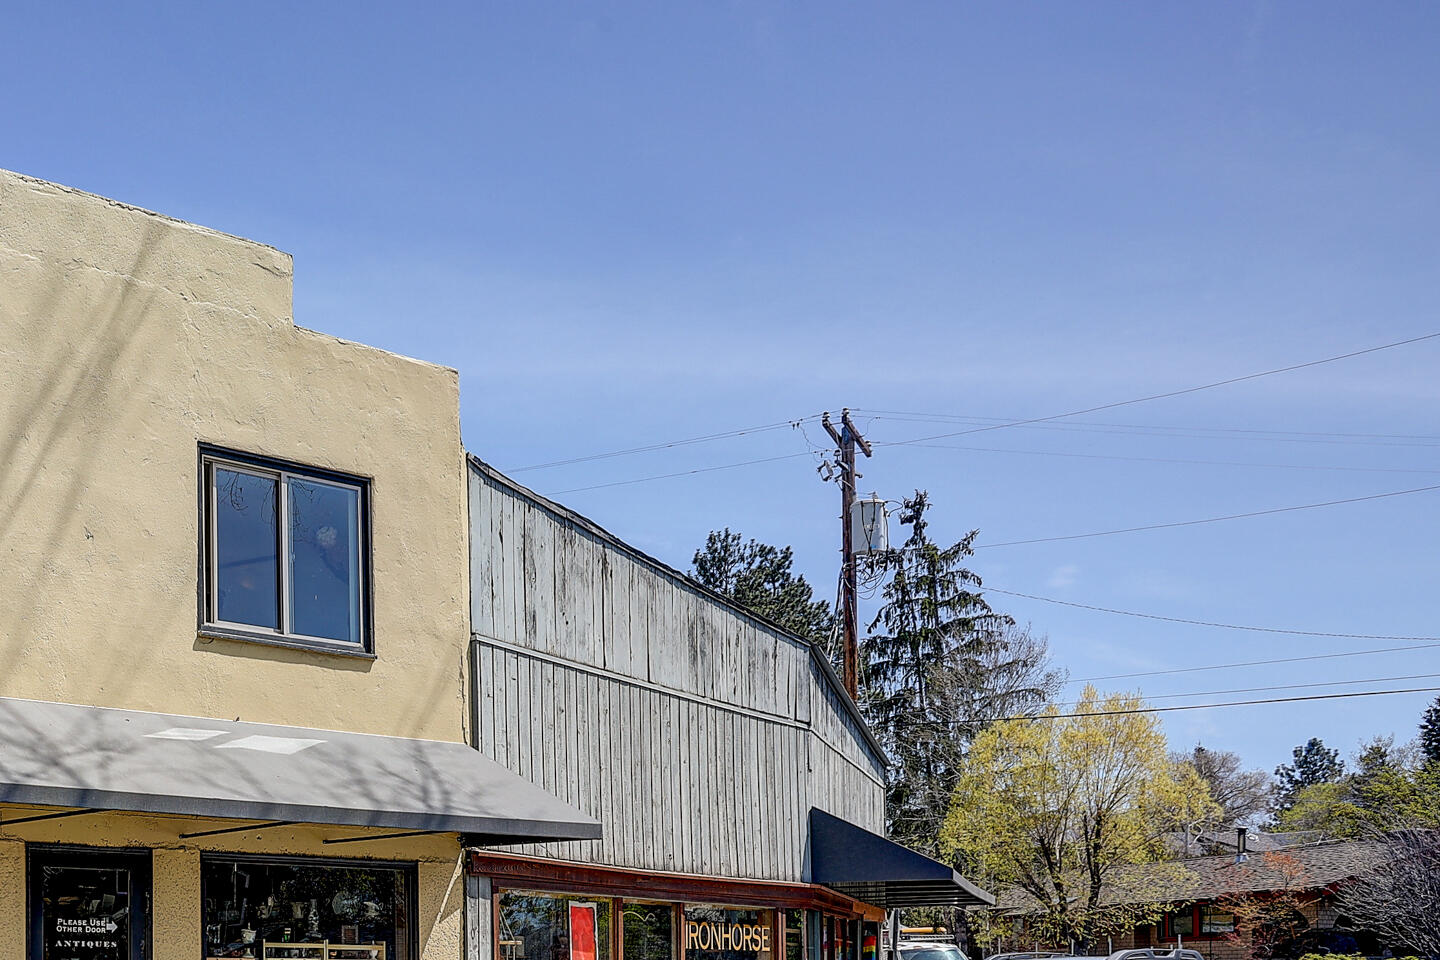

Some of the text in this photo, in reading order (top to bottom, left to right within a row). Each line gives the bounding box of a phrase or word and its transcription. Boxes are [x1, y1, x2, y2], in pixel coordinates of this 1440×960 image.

[57, 918, 106, 927] PLEASE USE
[56, 925, 83, 933] OTHER
[685, 921, 770, 951] IRONHORSE
[55, 940, 117, 949] ANTIQUES
